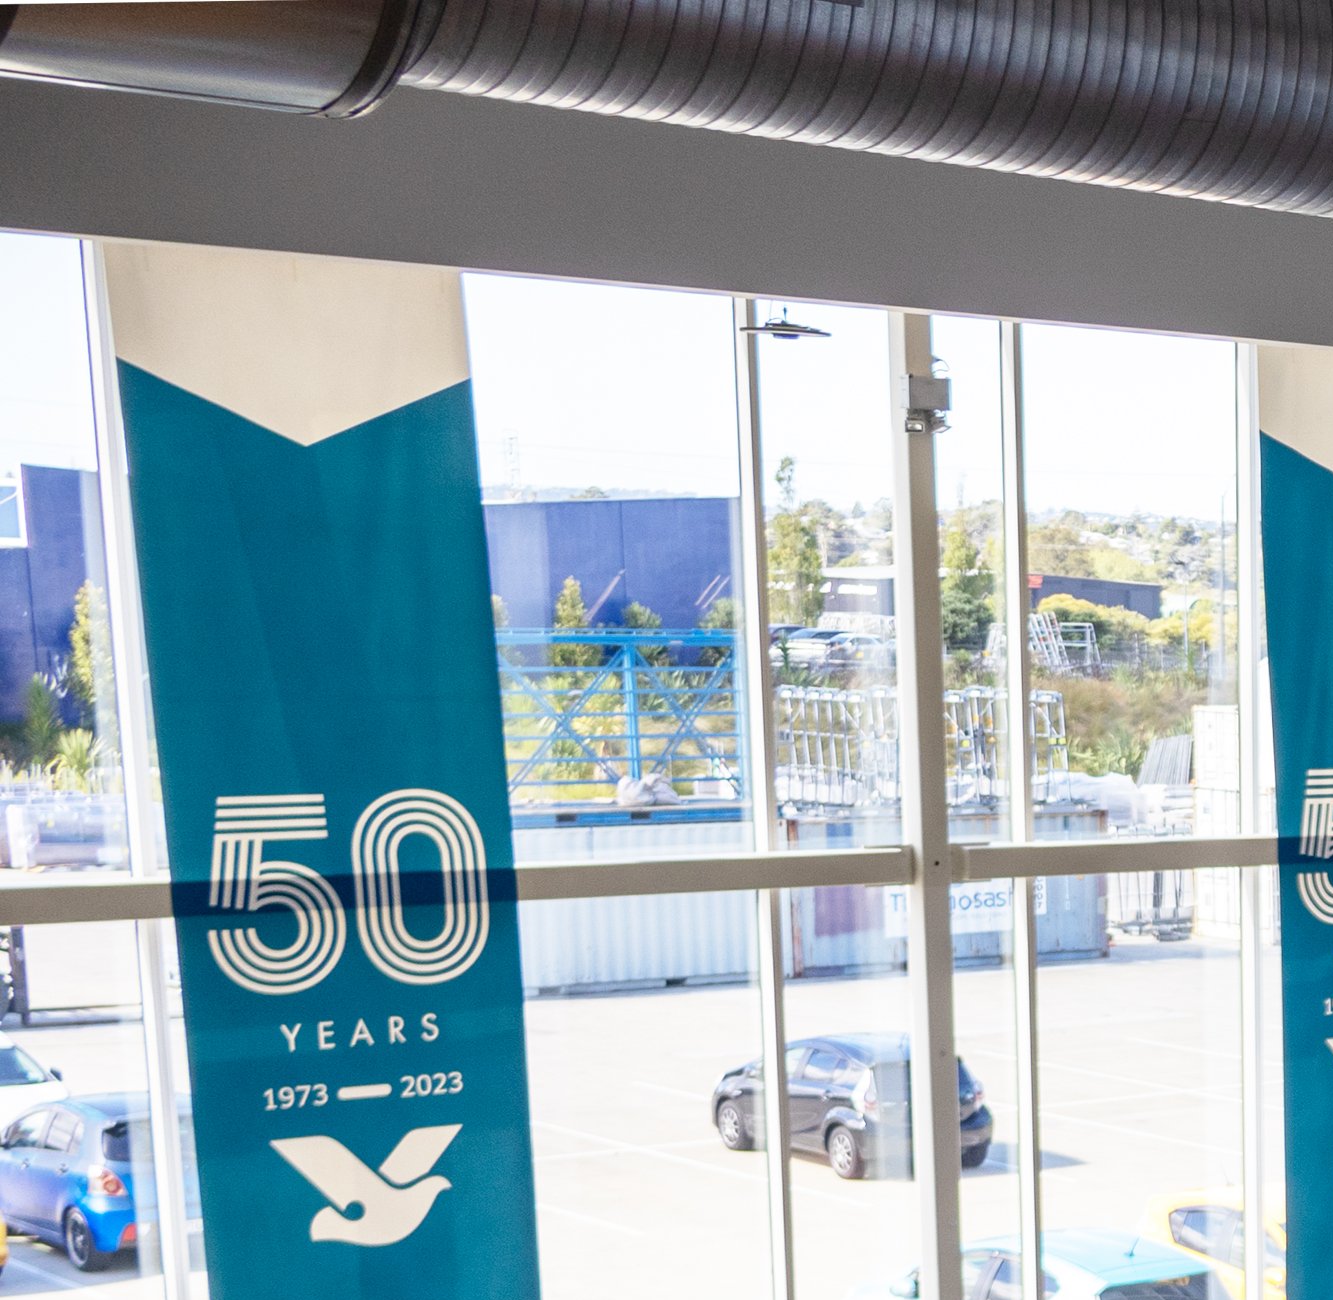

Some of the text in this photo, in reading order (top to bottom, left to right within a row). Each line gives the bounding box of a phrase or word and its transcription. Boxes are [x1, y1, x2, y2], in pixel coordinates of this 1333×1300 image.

[207, 787, 490, 995] 50
[890, 888, 1014, 912] Tosas
[280, 1012, 440, 1052] YEARS
[263, 1071, 464, 1111] 1973 2023
